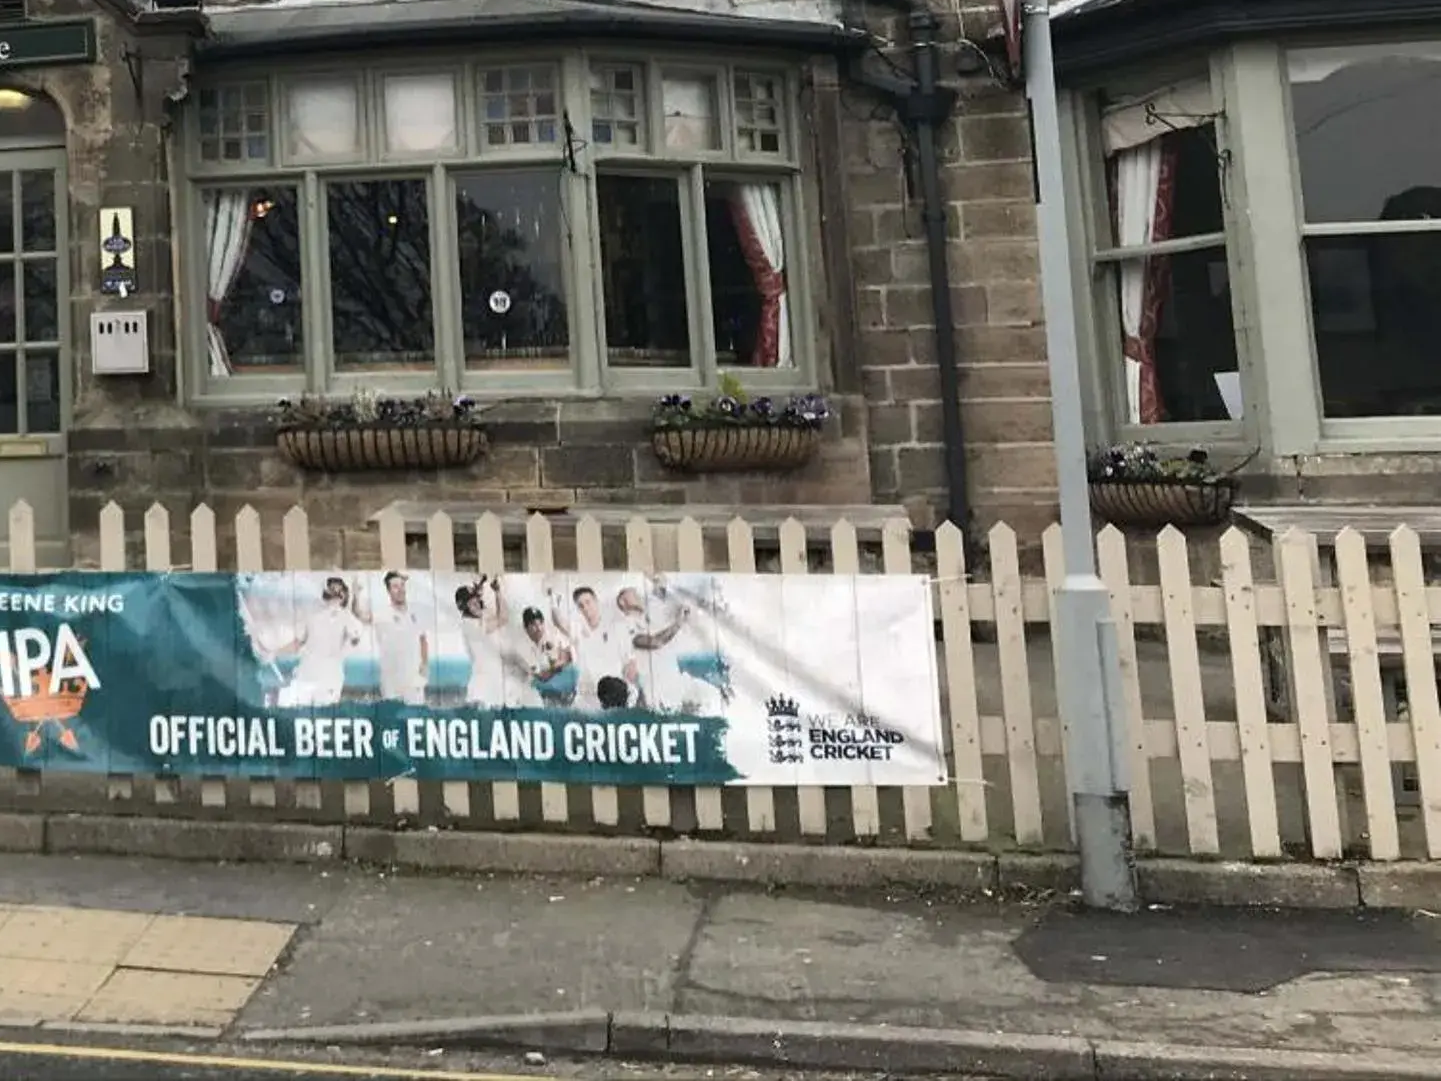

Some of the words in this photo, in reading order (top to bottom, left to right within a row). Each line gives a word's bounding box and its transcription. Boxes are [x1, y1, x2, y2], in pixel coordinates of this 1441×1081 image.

[64, 594, 125, 614] KING
[149, 715, 286, 758] OFFICIAL
[295, 718, 374, 759] BEER
[381, 729, 400, 749] OF
[406, 717, 554, 761] ENGLAND
[564, 722, 701, 764] CRICKET
[808, 728, 905, 744] ENGLAND
[810, 744, 895, 761] CRICKET
